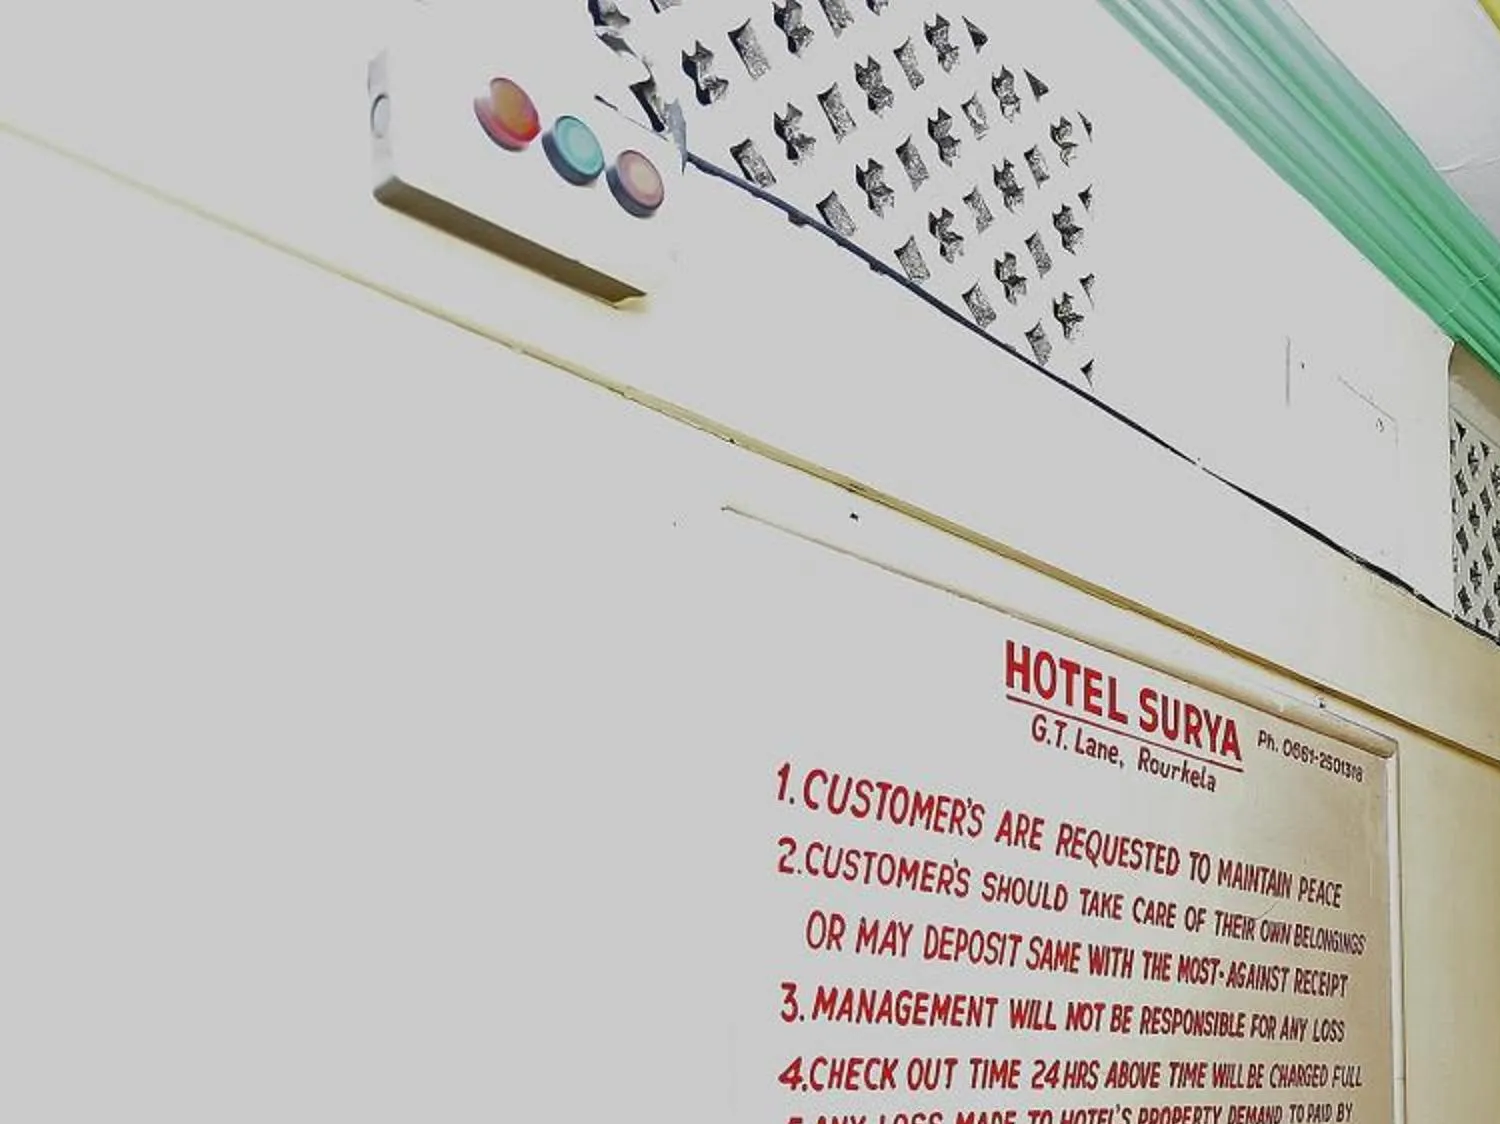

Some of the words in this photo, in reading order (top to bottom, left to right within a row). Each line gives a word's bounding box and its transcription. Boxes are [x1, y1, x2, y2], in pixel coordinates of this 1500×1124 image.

[1006, 640, 1128, 724] HOTEL
[1139, 687, 1242, 761] SURYA
[1032, 714, 1067, 750] G.T.
[1075, 728, 1124, 768] Lane,
[1138, 748, 1216, 792] Rourkela
[1258, 730, 1278, 752] Ph.
[995, 810, 1044, 851] ARE
[1055, 823, 1180, 876] REQUESTED
[1190, 851, 1211, 884] TO
[1218, 858, 1293, 899] MAINTAIN
[1298, 876, 1342, 908] PEACE
[982, 871, 1068, 912] SHOULD
[1080, 888, 1124, 920] TAKE
[1133, 897, 1177, 929] CARE
[1185, 906, 1207, 933] OF
[1215, 910, 1255, 939] THEIR
[1260, 919, 1291, 945] OWN
[1294, 924, 1366, 956] BELONGINGS
[806, 910, 846, 951] OR
[856, 917, 913, 957] MAY
[923, 925, 1023, 967] DEPOSIT
[1026, 936, 1081, 973] SAME
[1088, 944, 1134, 979] WITH
[1143, 951, 1172, 982] THE
[1294, 968, 1348, 998] RECEIPT
[1008, 998, 1057, 1031] WILL
[1066, 1001, 1105, 1033] NOT
[1110, 1003, 1134, 1033] BE
[1139, 1005, 1245, 1038] RESPONSIBLE
[1250, 1013, 1277, 1041] FOR
[1279, 1014, 1306, 1043] ANY
[1312, 1018, 1345, 1043] LOSS
[907, 1057, 958, 1091] OUT
[969, 1058, 1021, 1090] TIME
[1105, 1060, 1161, 1089] ABOVE
[1168, 1061, 1207, 1089] TIME
[1212, 1062, 1246, 1089] WILL
[1247, 1064, 1264, 1089] BE
[1269, 1063, 1328, 1089] CHARGED
[1332, 1065, 1363, 1088] FULL
[1289, 1103, 1304, 1124] TO
[1306, 1102, 1333, 1123] PAID
[1335, 1102, 1353, 1123] BY
